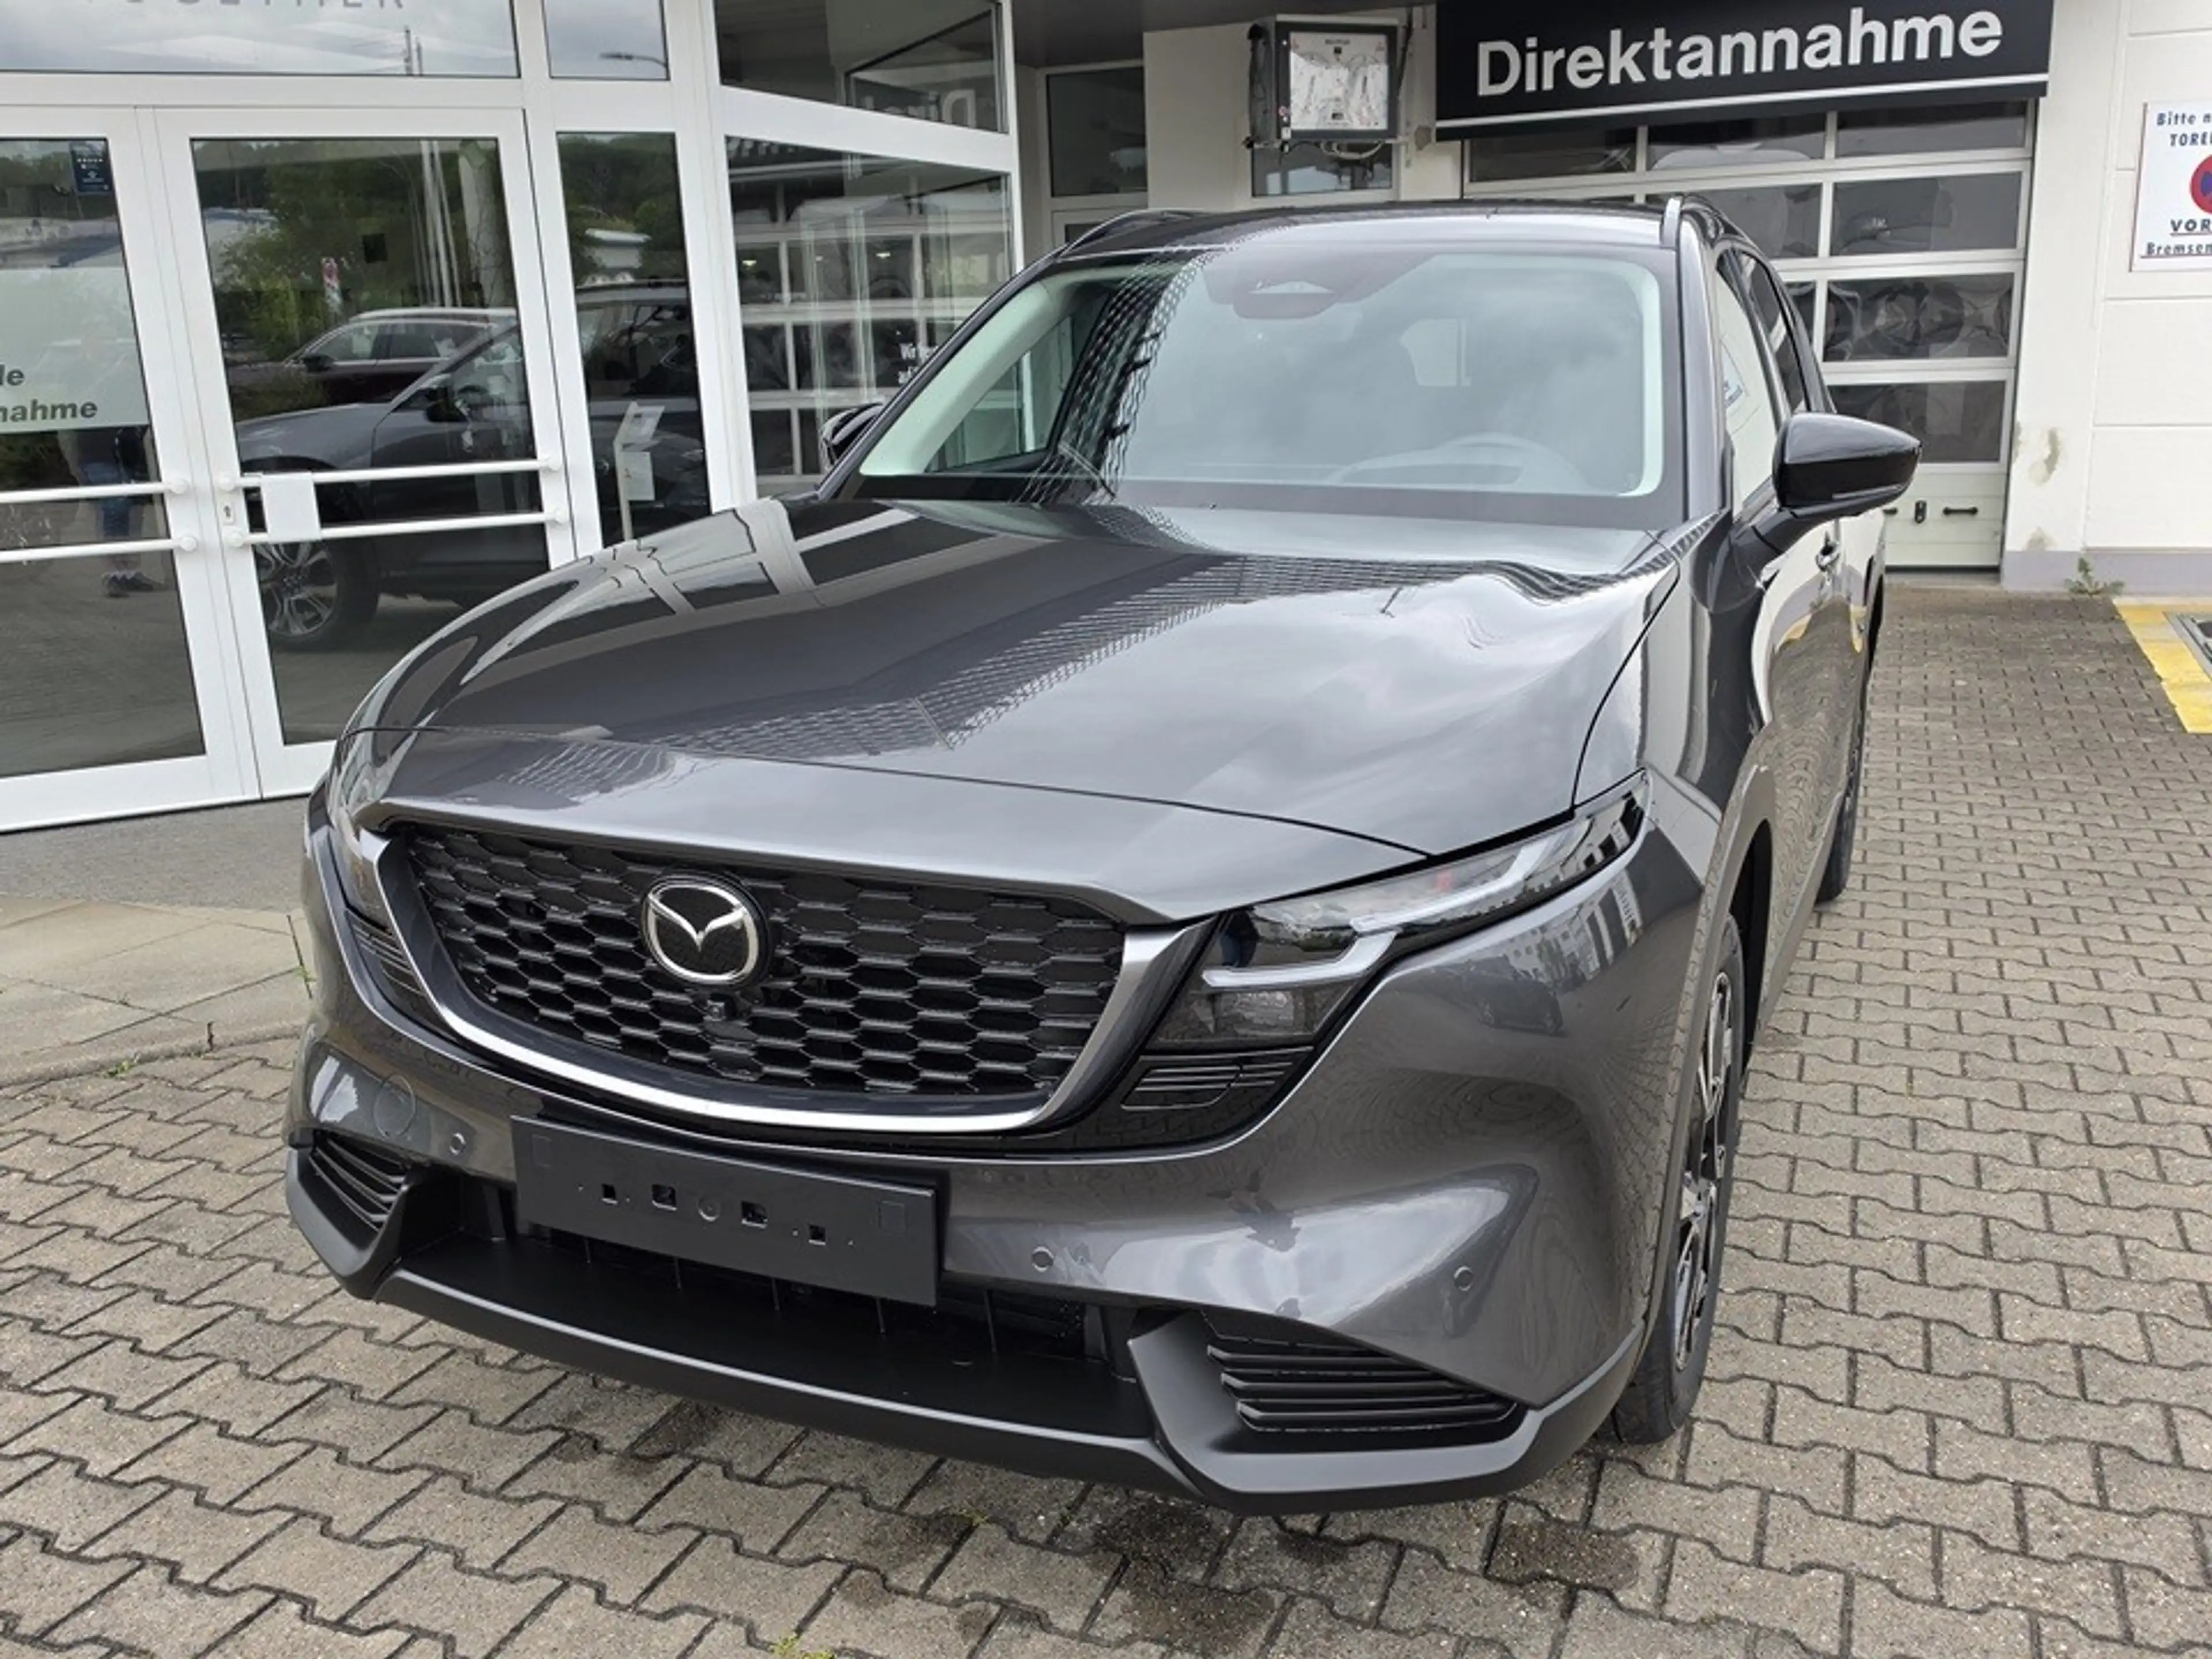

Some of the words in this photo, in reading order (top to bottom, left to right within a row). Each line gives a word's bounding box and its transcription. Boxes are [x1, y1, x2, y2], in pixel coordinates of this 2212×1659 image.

[1477, 7, 2003, 97] Direktannahme
[2156, 111, 2196, 126] Bitte
[2169, 131, 2212, 147] TORE
[2170, 218, 2211, 232] VOR
